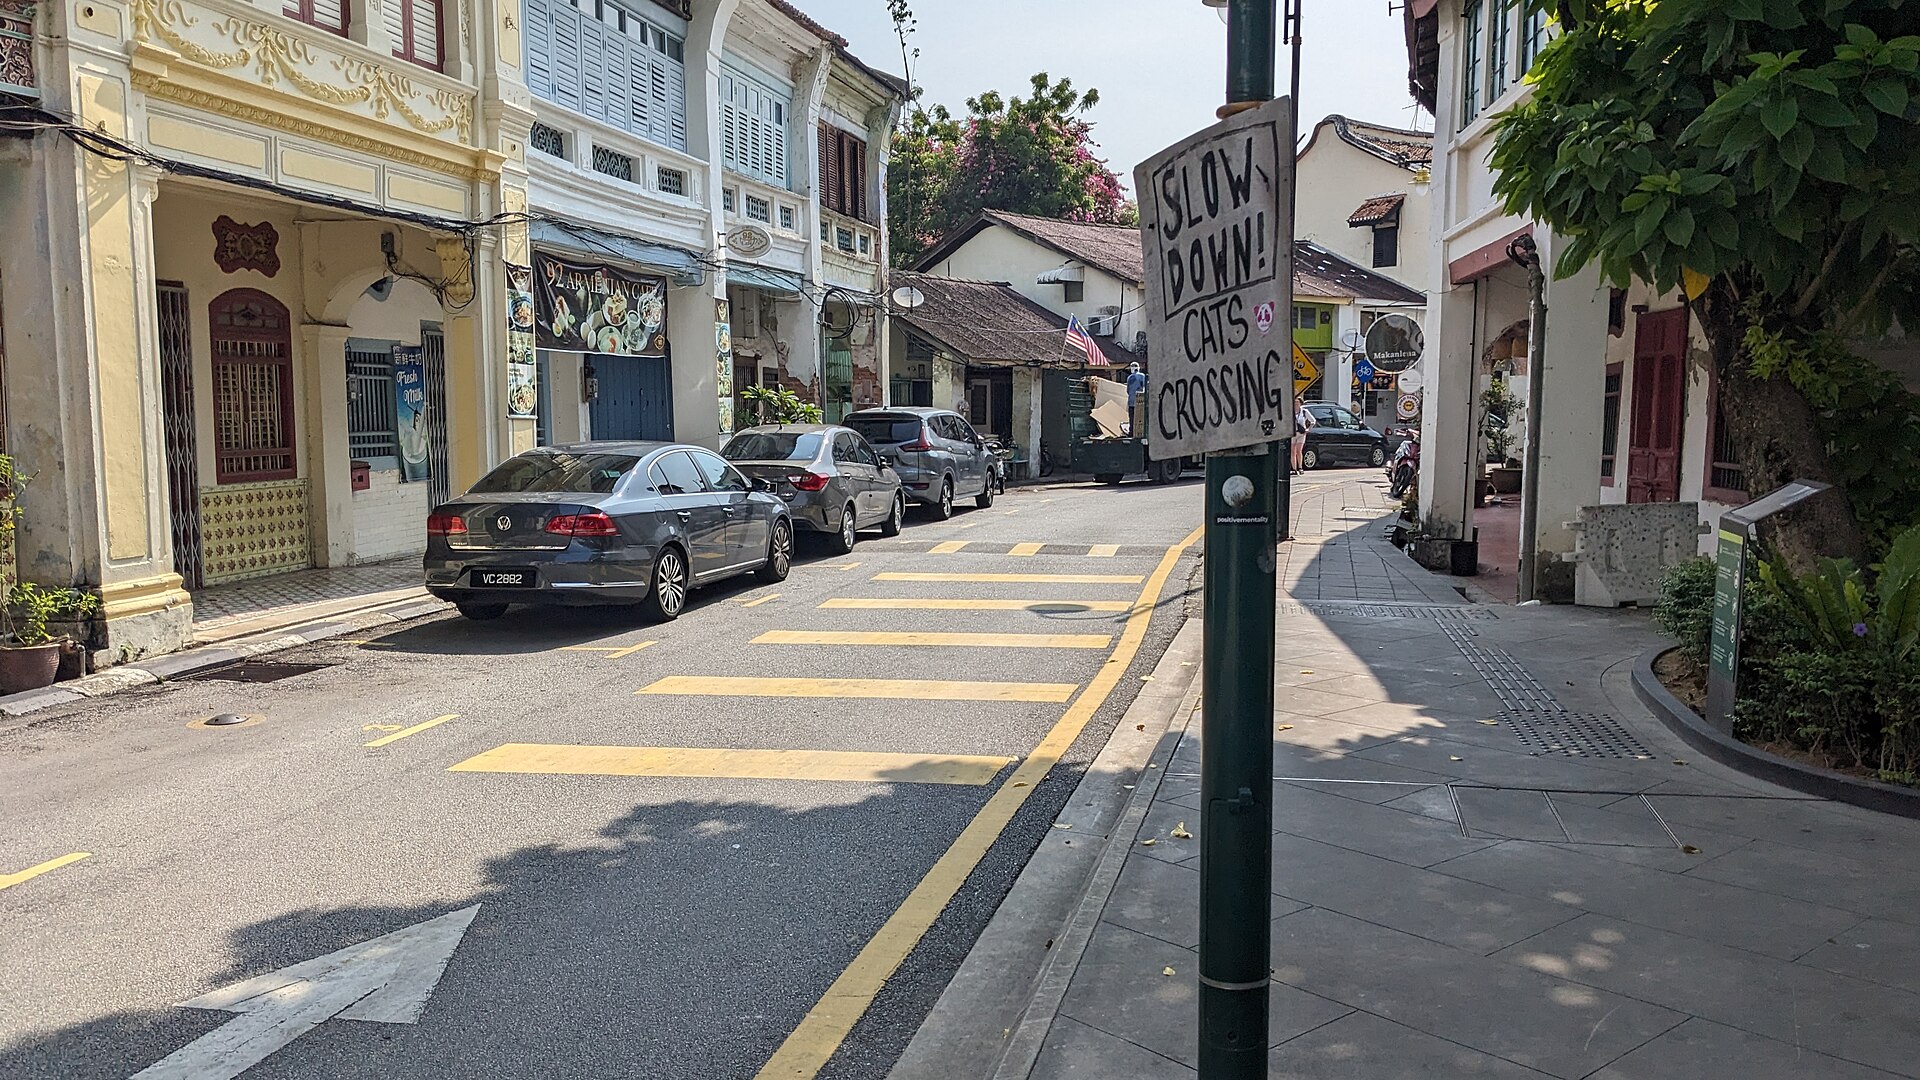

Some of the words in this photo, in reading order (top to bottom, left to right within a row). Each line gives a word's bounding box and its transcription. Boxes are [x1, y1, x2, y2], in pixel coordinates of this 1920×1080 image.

[1162, 137, 1253, 241] SLOW
[547, 261, 564, 287] 92
[566, 271, 630, 299] ARMENIAN
[1168, 211, 1265, 306] DOWN!
[1183, 293, 1249, 363] CATS
[396, 369, 418, 387] Fresh
[403, 388, 423, 405] Milk
[1158, 350, 1282, 440] CROSSING
